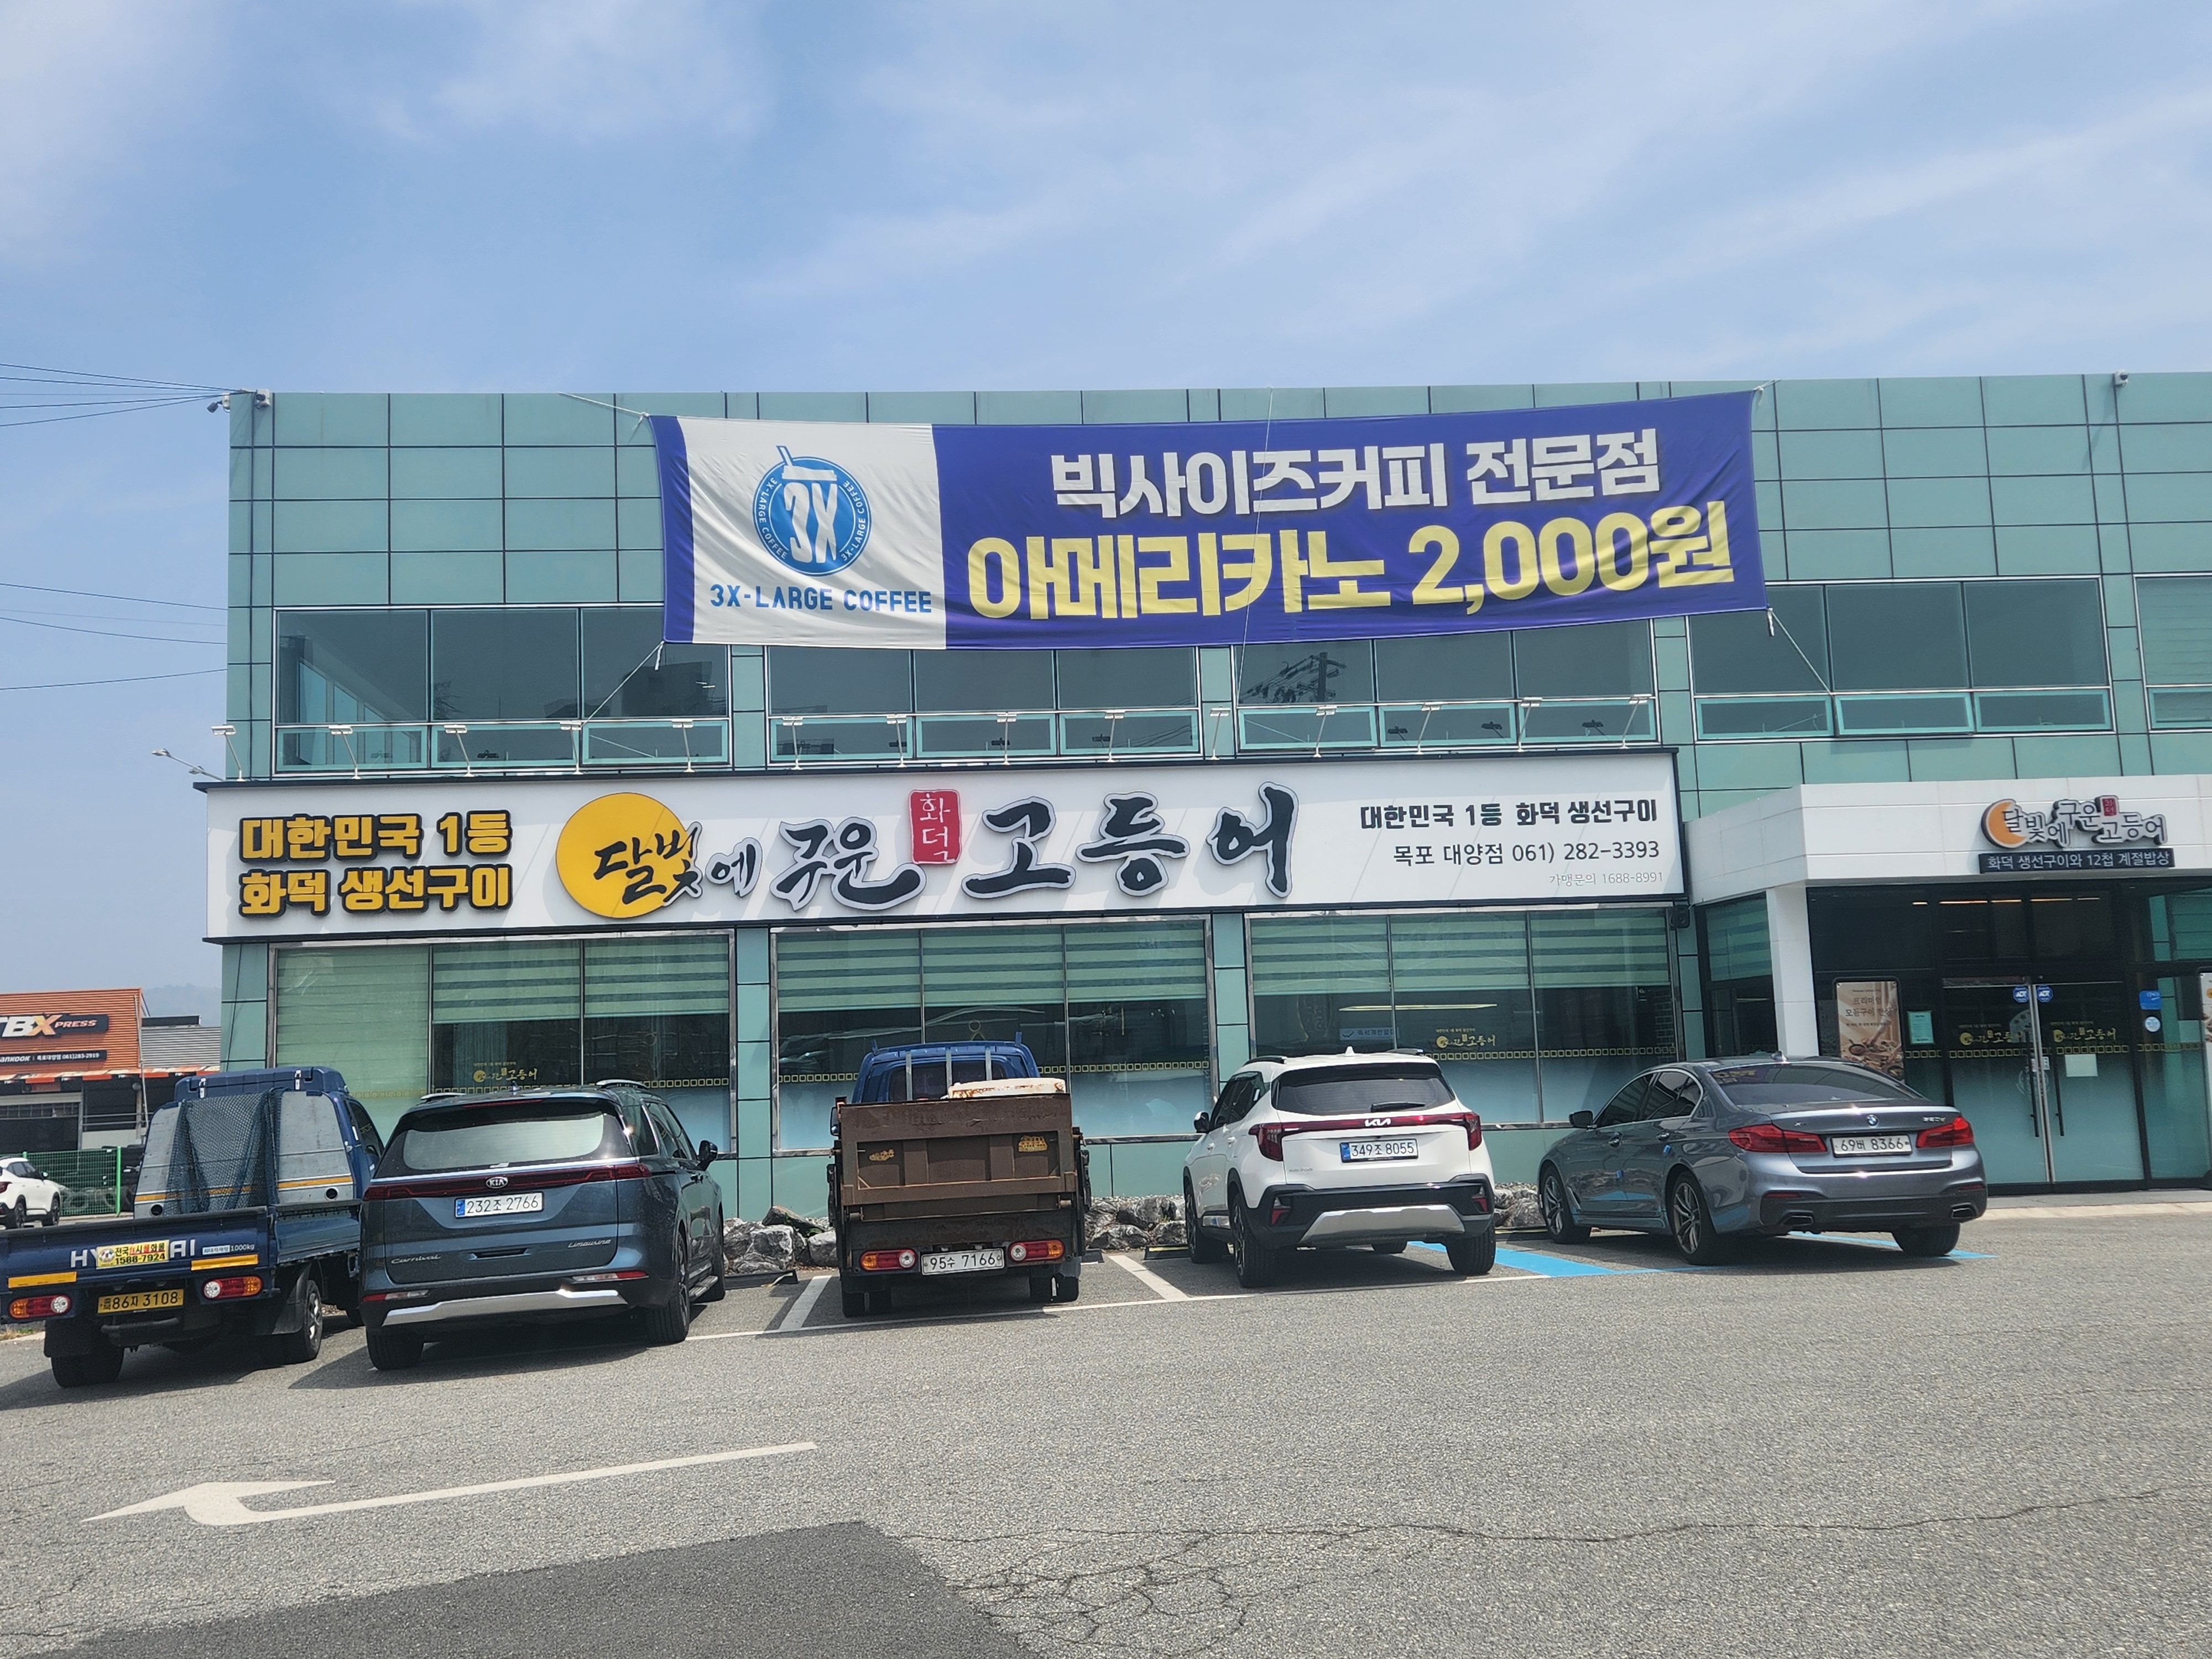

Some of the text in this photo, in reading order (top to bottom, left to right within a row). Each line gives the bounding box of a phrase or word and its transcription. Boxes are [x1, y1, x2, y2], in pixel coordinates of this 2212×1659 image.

[1051, 428, 1660, 518] 빅사이즈커피 전문점
[843, 480, 865, 514] COFFEE
[784, 482, 838, 563] 3X
[762, 527, 787, 560] COFFEE
[968, 500, 1734, 619] 아메리카노 2,000원
[710, 583, 932, 613] 3X-LARGE COFFEE
[1361, 799, 1657, 829] 대한민국 1등 화덕 생선구이
[2058, 802, 2100, 828] 구운
[2101, 815, 2167, 843] 고등어
[239, 810, 512, 860] 대한민국 1등
[776, 822, 920, 907] 구운
[919, 793, 956, 862] 화덕
[966, 787, 1291, 895] 고등어
[1394, 841, 1659, 866] 목포 대양점 061) 282-3393
[1988, 851, 2169, 869] 화덕 생선구이와 12첩 계절밥상
[240, 864, 511, 917] 화덕 생선구이
[1549, 872, 1663, 886] 가맹문의 1688-8991
[1352, 1142, 1414, 1157] 349조 8055
[1841, 1138, 1903, 1151] 69버 8366
[489, 1178, 504, 1187] KIA
[467, 1197, 539, 1214] 232조 2766
[116, 1253, 165, 1265] 1588-7924
[391, 1254, 441, 1265] Carnival
[930, 1253, 995, 1270] 95수 7166
[112, 1296, 138, 1310] 86자
[143, 1292, 178, 1306] 3108
